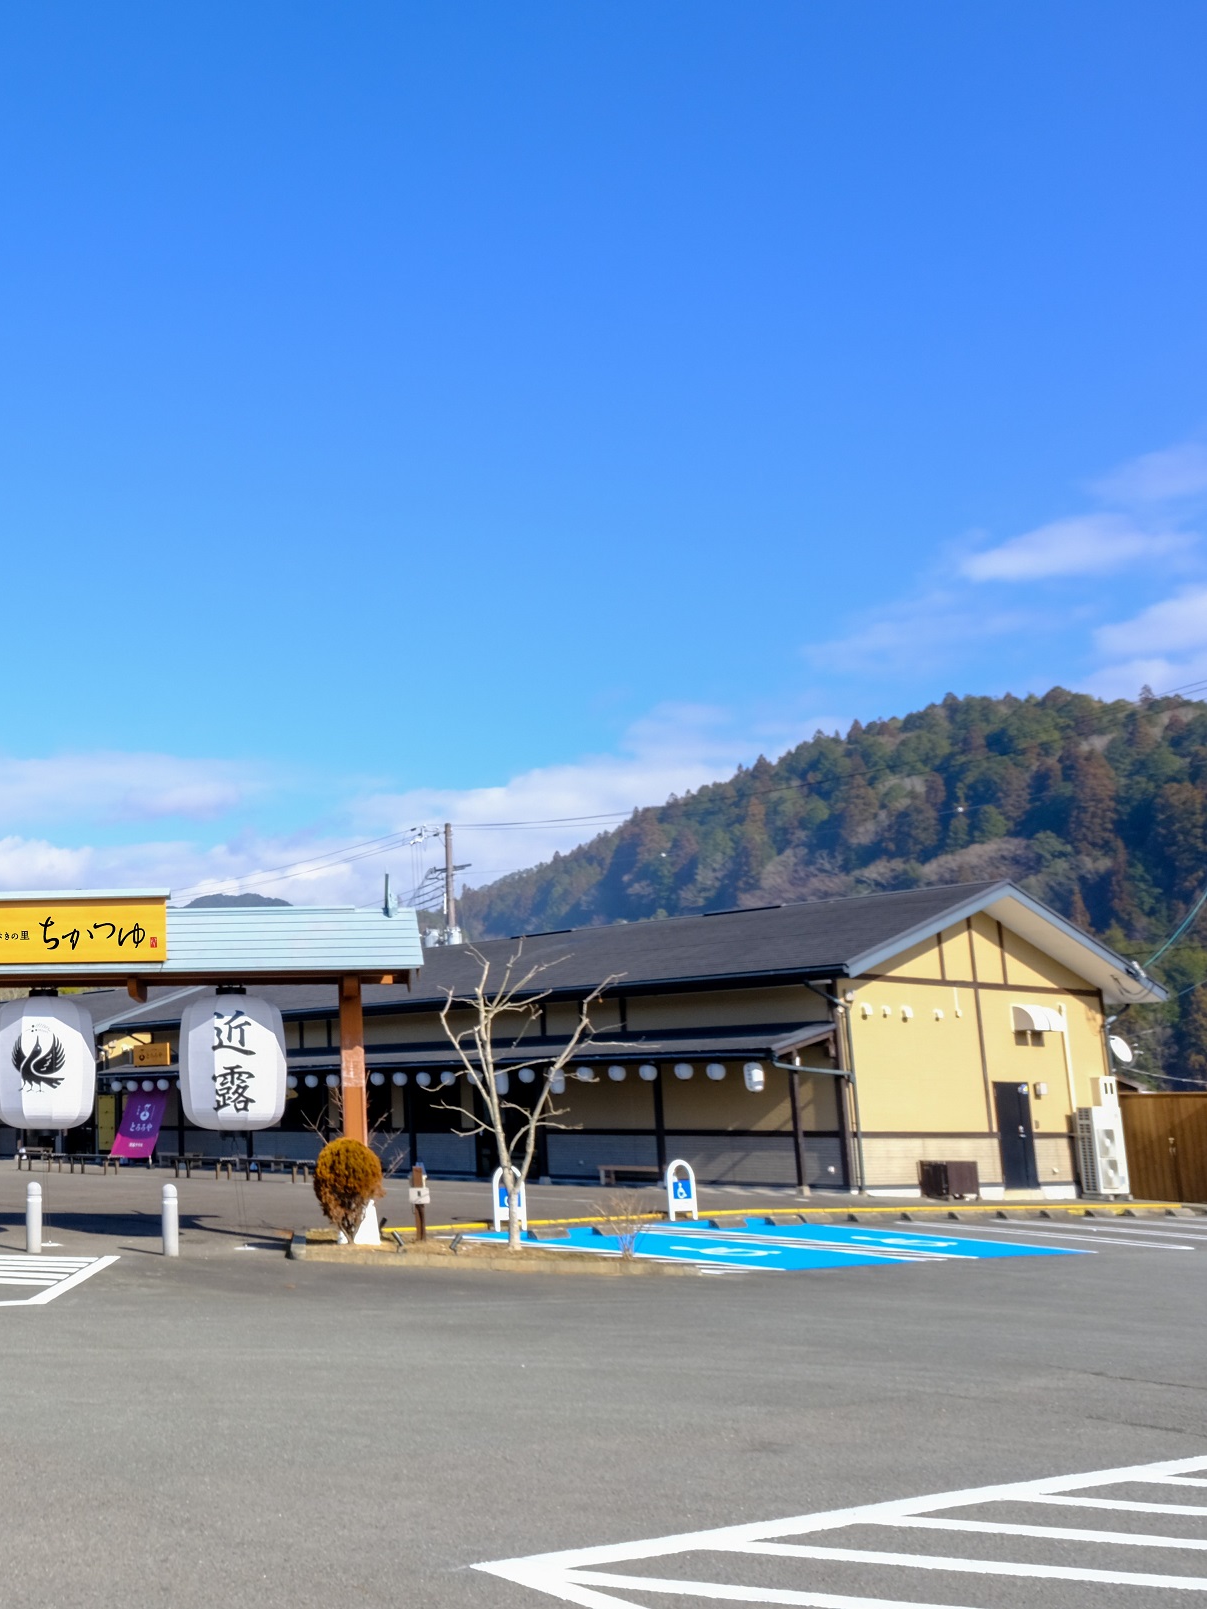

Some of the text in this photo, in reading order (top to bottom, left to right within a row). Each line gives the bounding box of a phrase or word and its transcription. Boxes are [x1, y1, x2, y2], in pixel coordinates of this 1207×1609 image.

[38, 916, 146, 950] ちかつゆ
[211, 1010, 256, 1113] 近露
